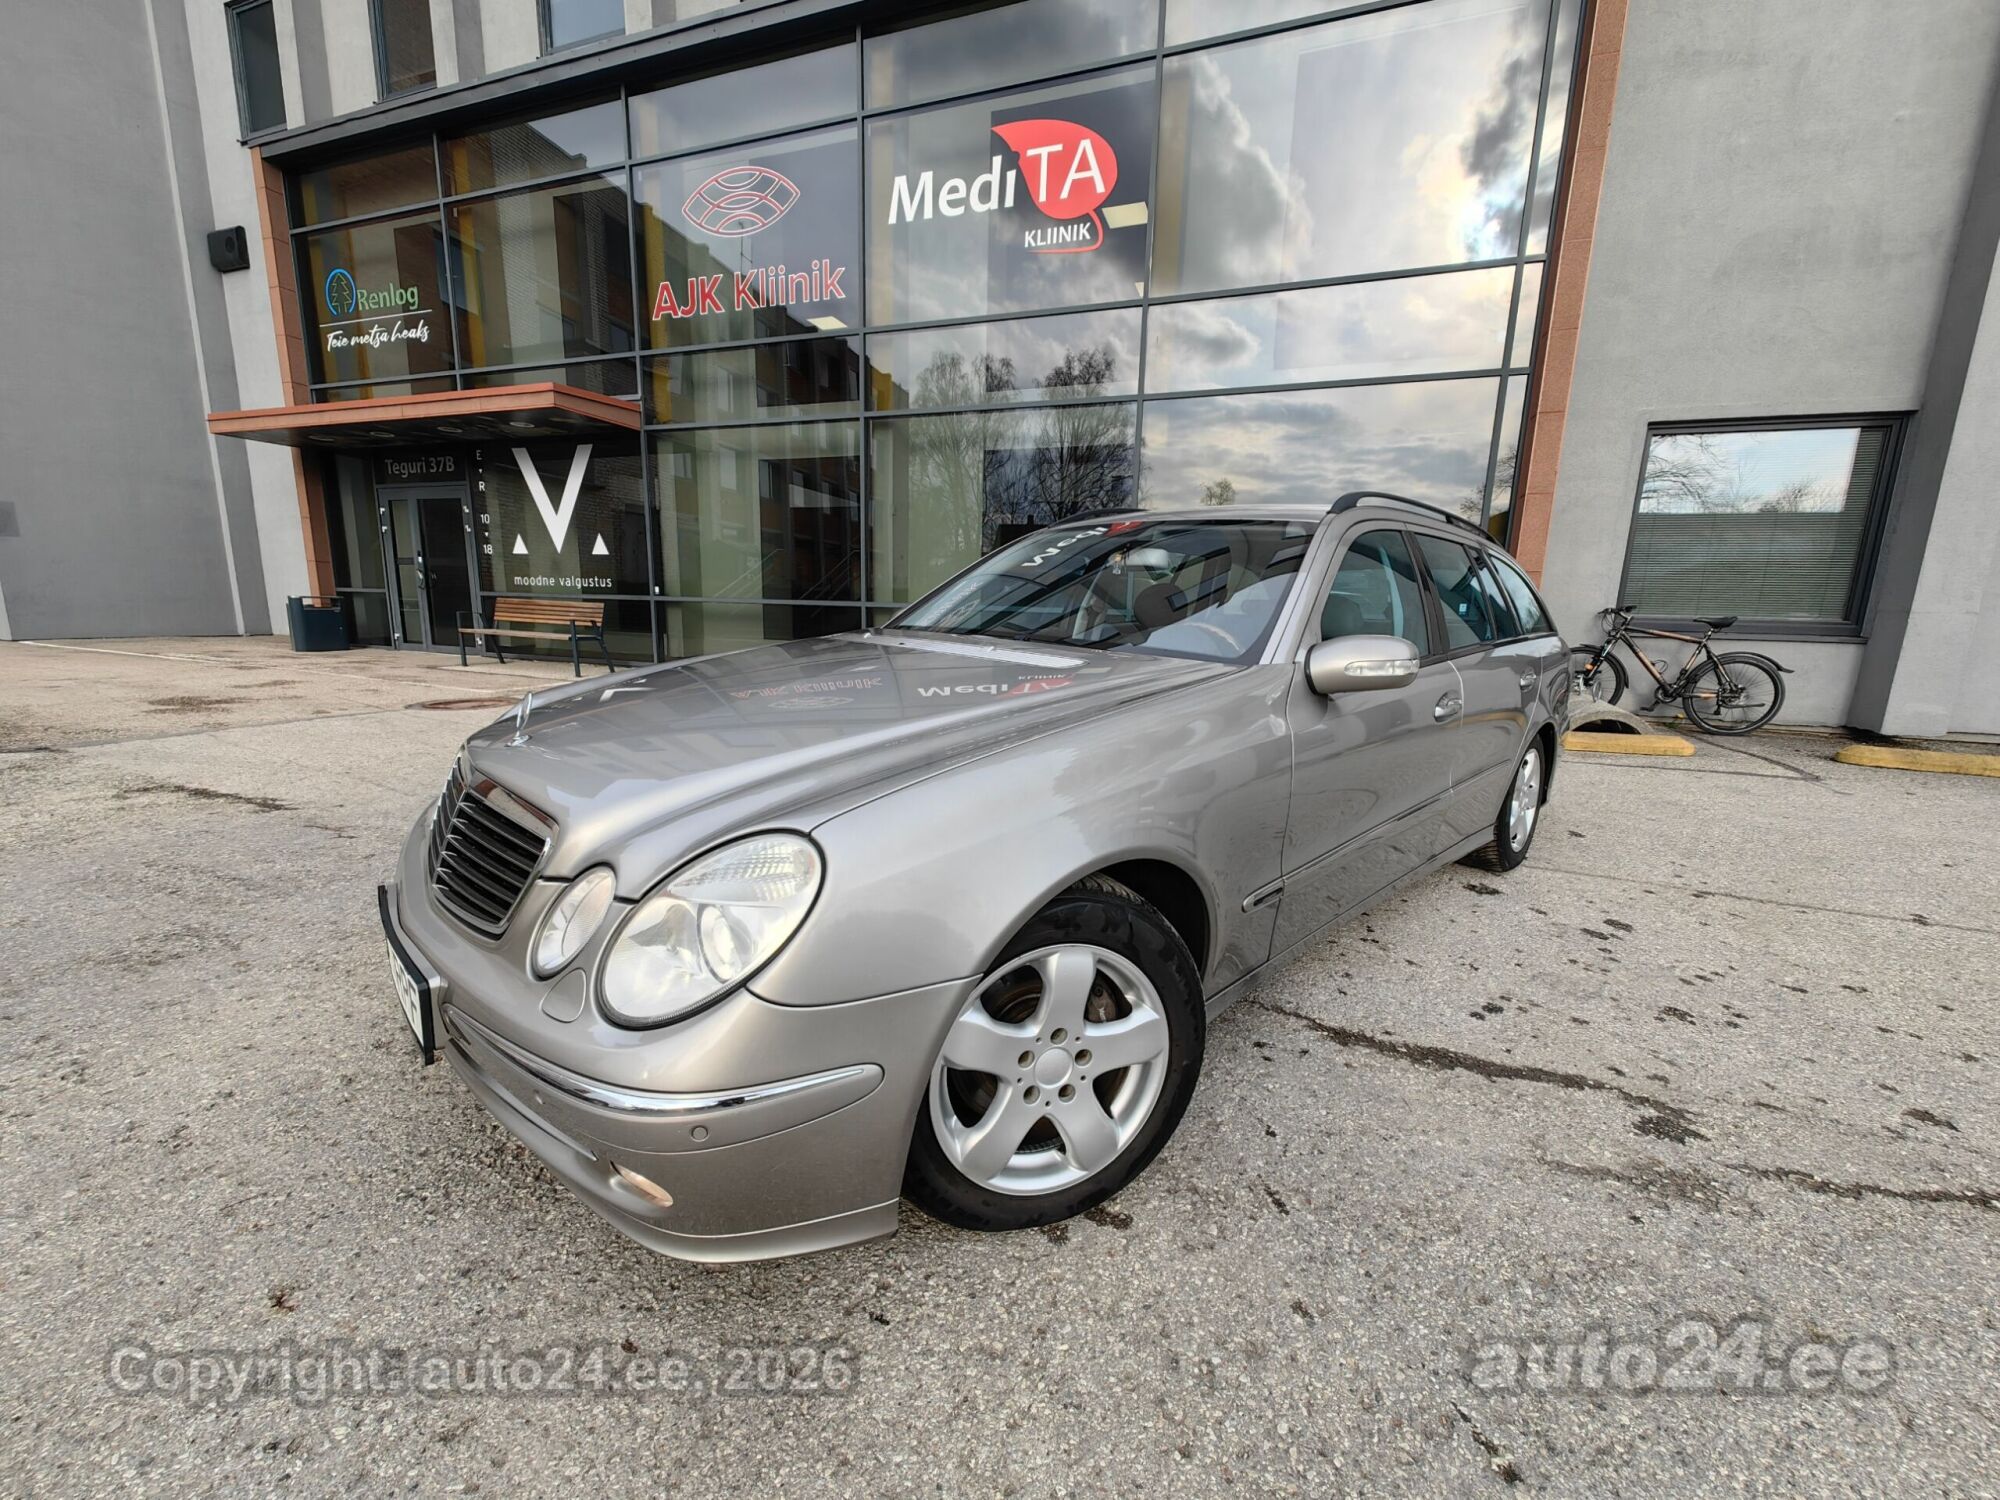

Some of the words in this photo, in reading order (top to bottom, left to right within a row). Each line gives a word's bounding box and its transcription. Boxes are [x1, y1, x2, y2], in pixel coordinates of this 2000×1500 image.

[1024, 222, 1091, 248] KLIINIK
[356, 283, 419, 311] Renlog
[652, 274, 726, 321] AJK
[734, 259, 847, 311] Kliinik
[326, 330, 349, 352] Teie
[350, 324, 389, 348] metsa
[391, 320, 430, 342] heaks
[476, 450, 483, 460] E
[385, 457, 426, 478] Teguri
[429, 456, 455, 473] 37B
[479, 481, 486, 491] R
[481, 514, 491, 524] 10
[483, 544, 493, 554] 18
[514, 575, 555, 586] moodne
[559, 575, 613, 589] valgustus
